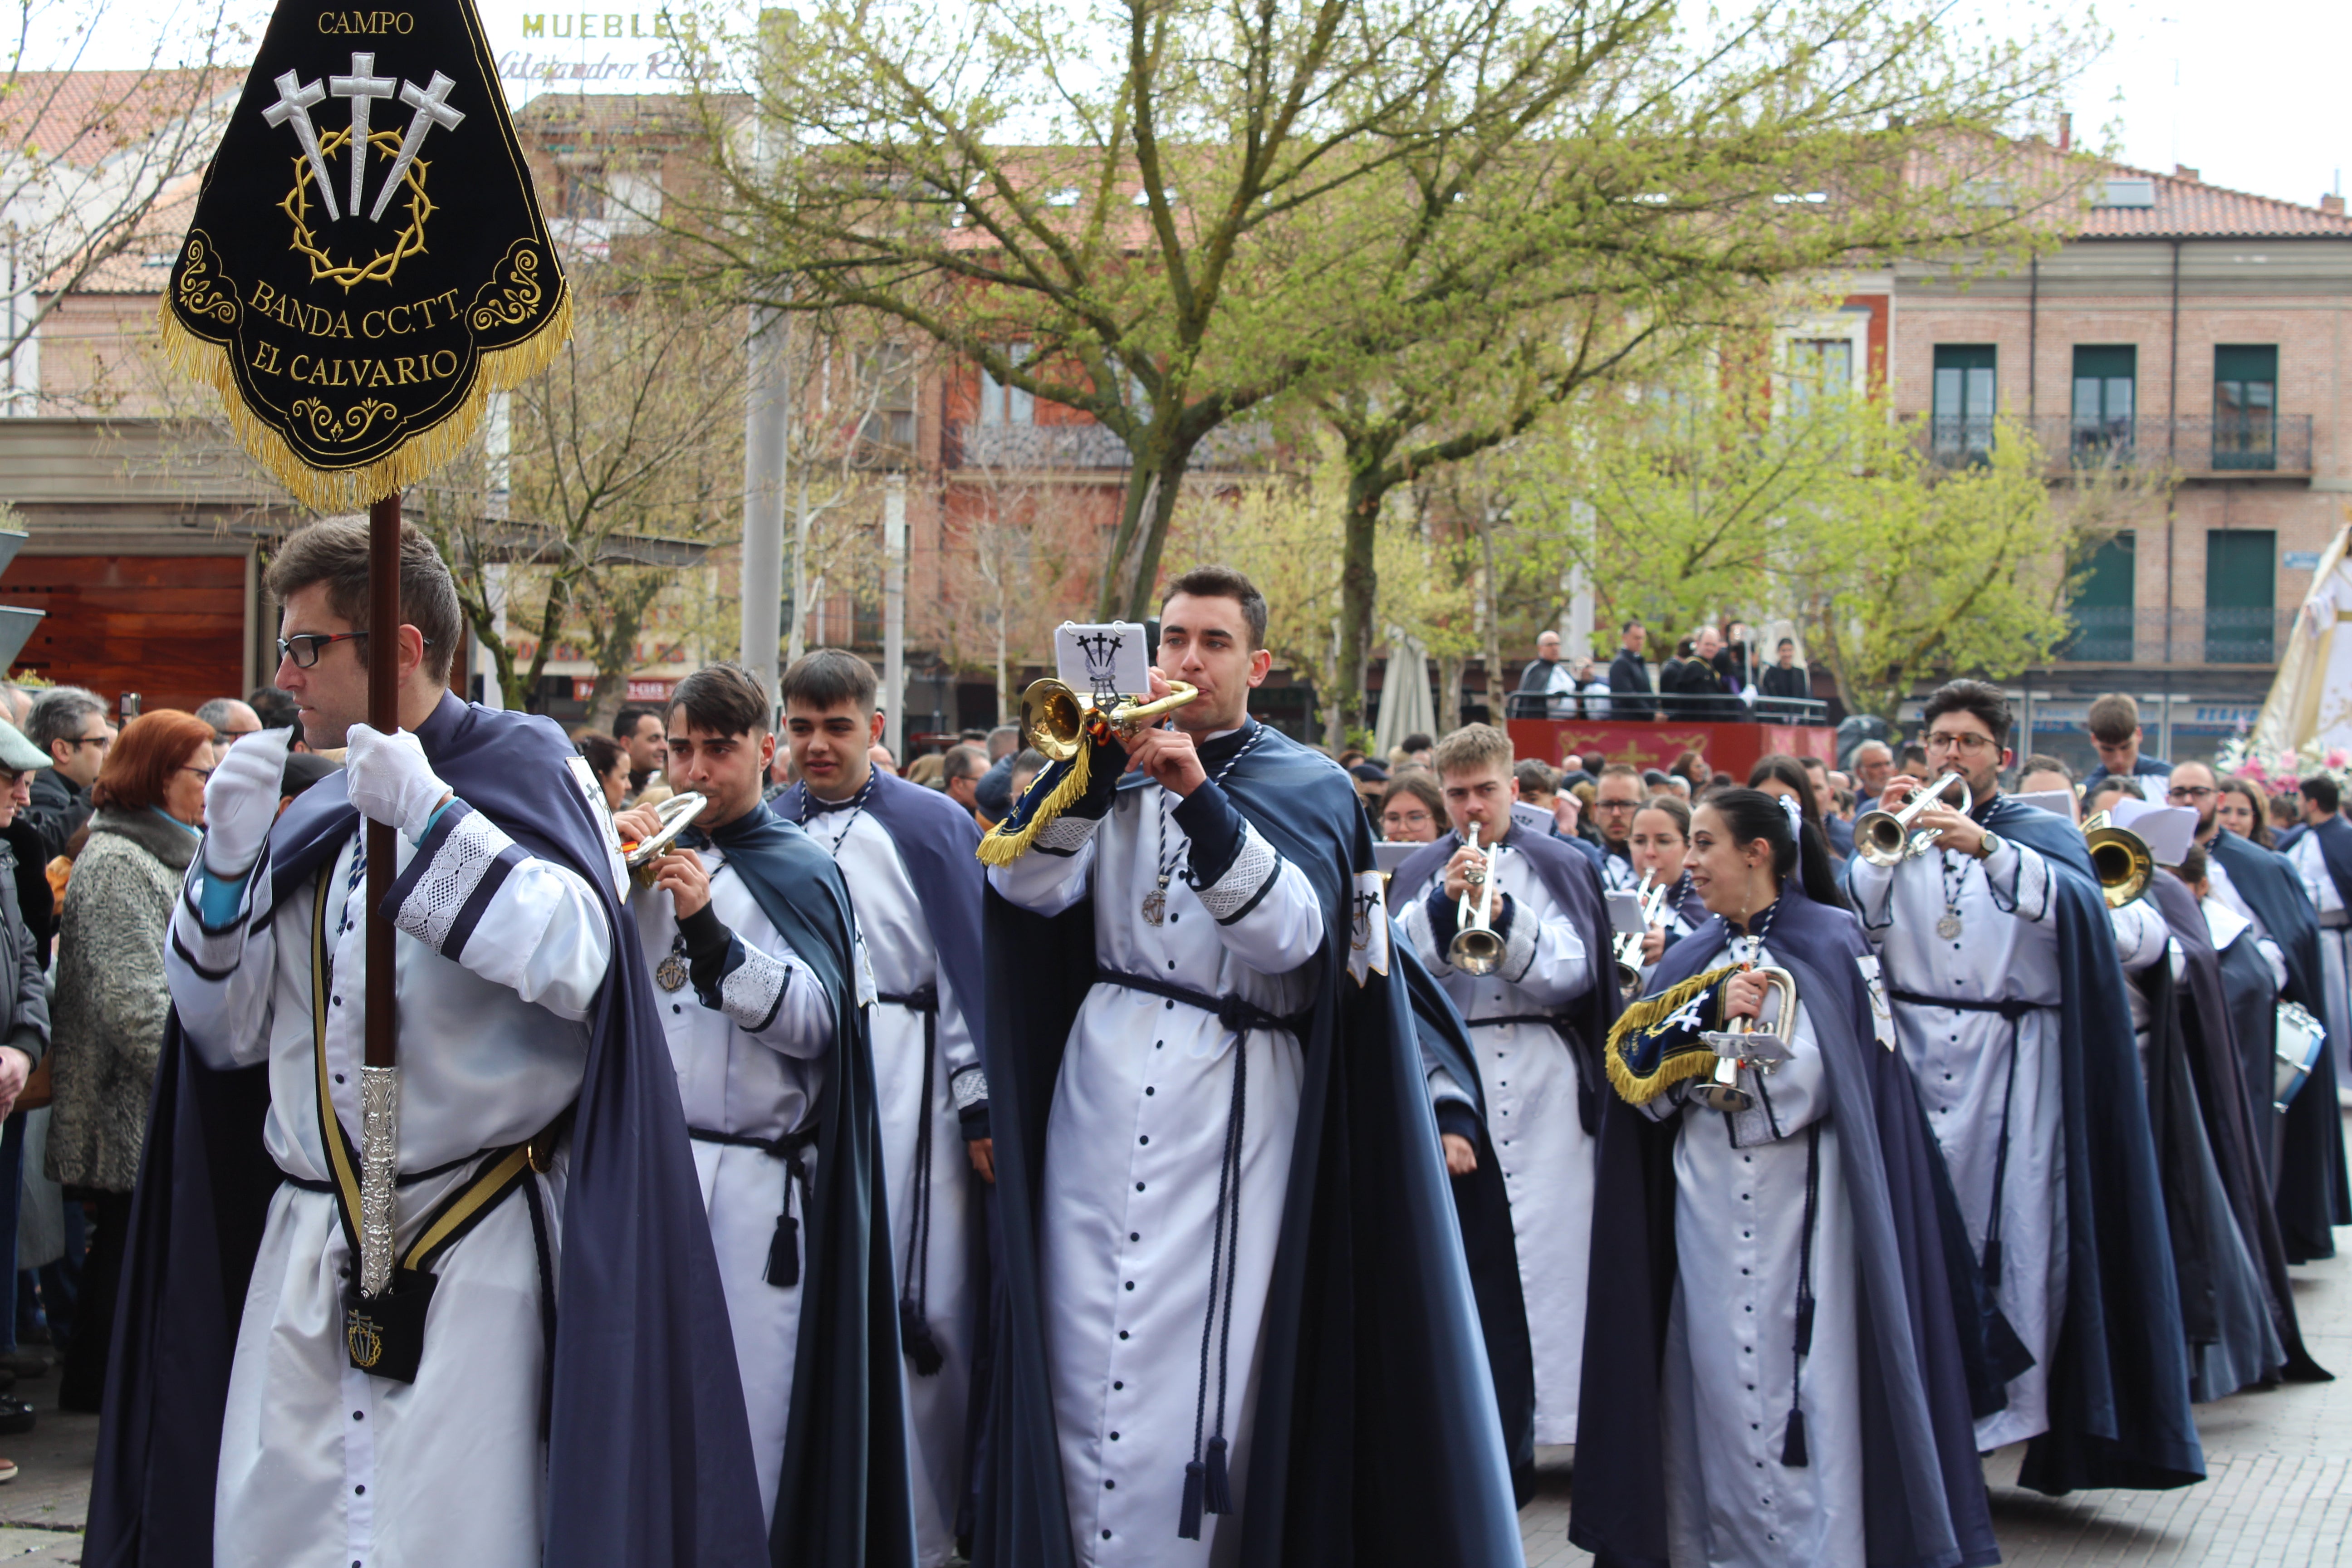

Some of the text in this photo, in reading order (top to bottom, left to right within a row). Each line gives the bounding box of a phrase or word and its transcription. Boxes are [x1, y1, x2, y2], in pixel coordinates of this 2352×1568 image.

[318, 11, 414, 34] CAMPO
[523, 14, 699, 38] MUEBLES
[248, 280, 354, 338] BANDA
[252, 341, 457, 387] EL CALVARIO
